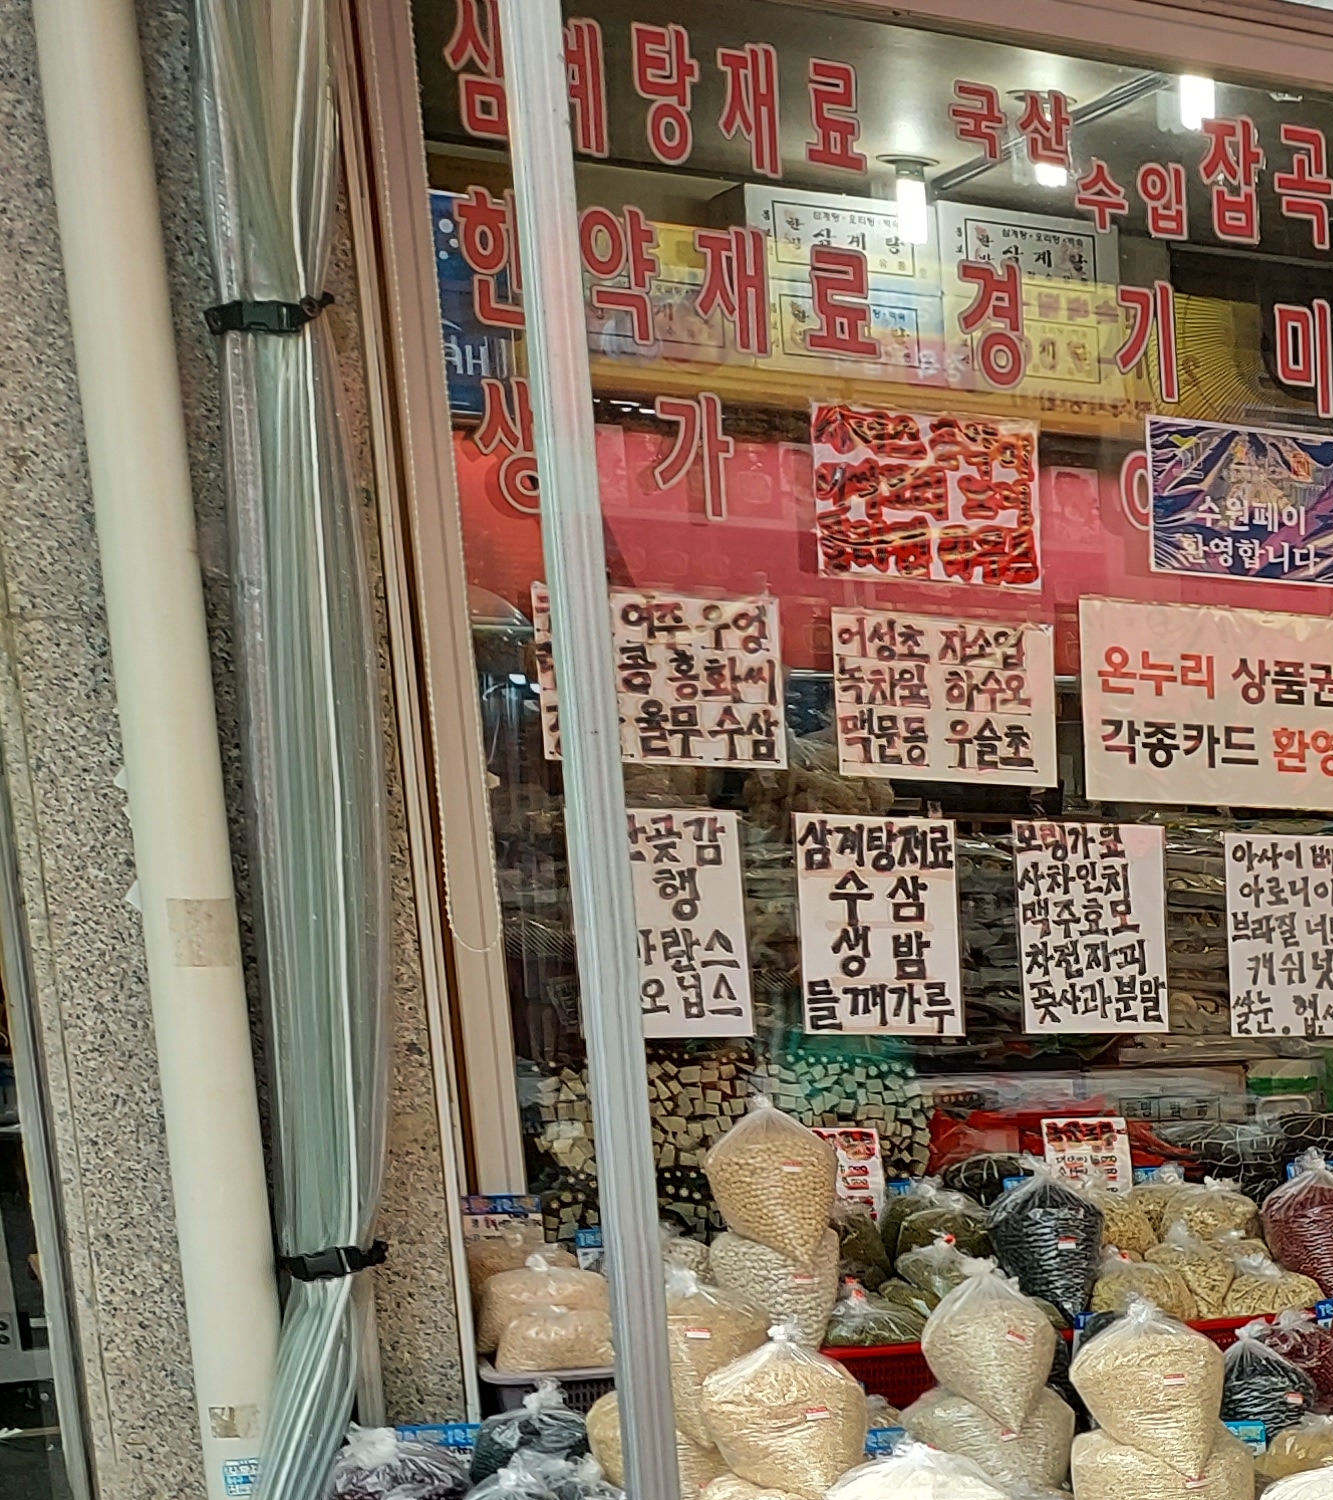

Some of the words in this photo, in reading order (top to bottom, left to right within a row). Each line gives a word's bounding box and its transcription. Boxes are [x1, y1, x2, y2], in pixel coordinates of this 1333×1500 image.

[444, 0, 868, 178] 삼계탕재료
[951, 78, 1072, 162] 국산
[1076, 158, 1188, 240] 수입
[453, 185, 881, 359] 한약재료
[1196, 495, 1306, 535] 수원페이
[1180, 533, 1320, 574] 환영합니다
[700, 604, 770, 654] 우엉
[837, 617, 930, 663] 어성초
[667, 648, 776, 705] 홍화씨
[945, 669, 1032, 712] 하수오
[1098, 646, 1214, 700] 온누리
[635, 700, 702, 758] 율무
[709, 704, 779, 760] 수삼
[839, 708, 929, 767] 맥문동
[944, 717, 1036, 770] 우슬초
[1101, 718, 1259, 769] 각종카드
[798, 820, 953, 871] 삼계탕재료
[1231, 841, 1303, 871] 아사이
[1017, 861, 1131, 899] 사차인치
[1021, 898, 1140, 939] 맥주효모
[1231, 911, 1300, 947] 브라질
[1025, 939, 1146, 979] 차전자피
[807, 979, 956, 1033] 들깨가루
